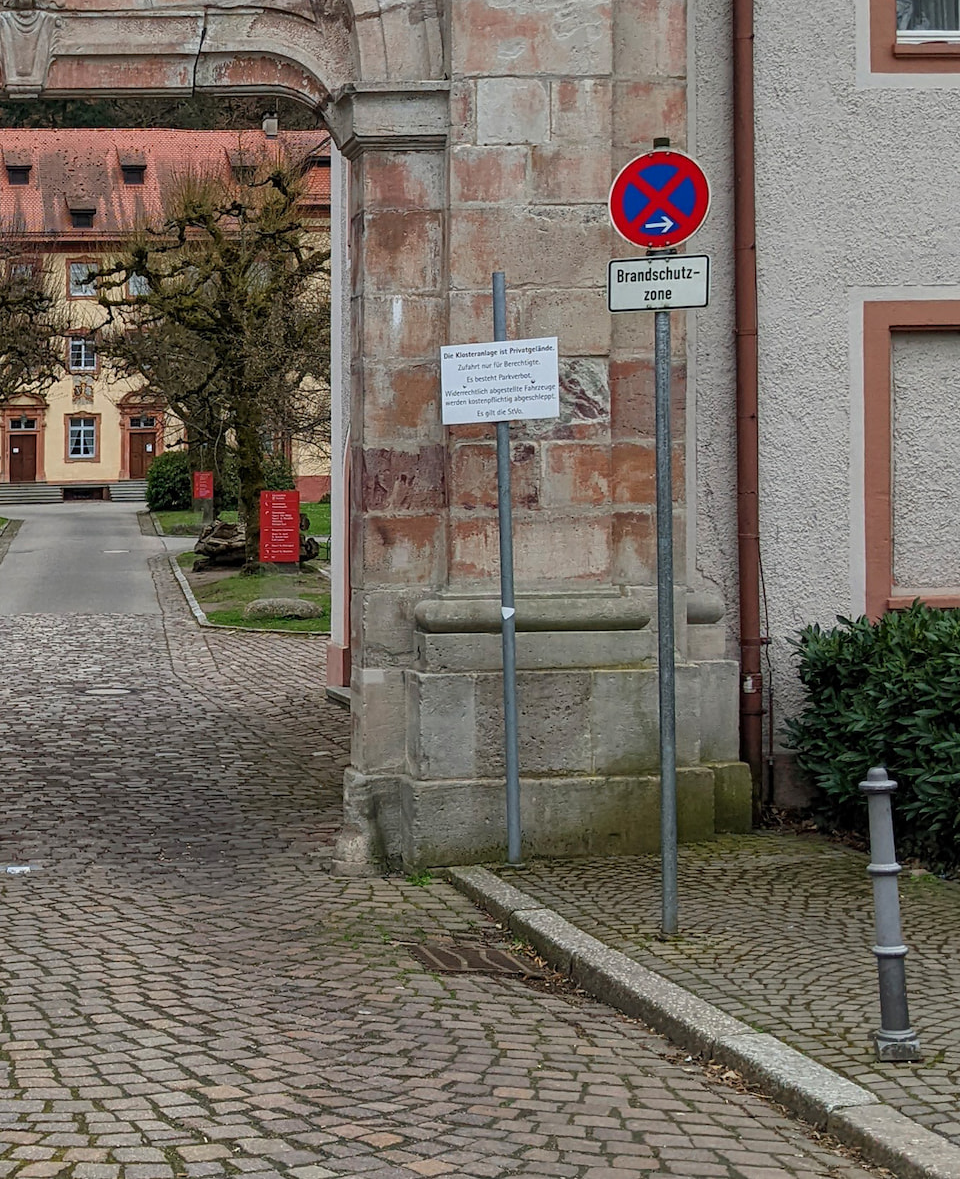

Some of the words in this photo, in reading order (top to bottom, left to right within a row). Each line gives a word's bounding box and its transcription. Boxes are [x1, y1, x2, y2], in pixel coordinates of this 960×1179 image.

[617, 265, 700, 283] Brandschutz-
[644, 289, 672, 301] zone
[455, 350, 498, 359] Klosteranlage
[509, 345, 555, 355] Privatgelände.
[504, 359, 541, 368] Berechtigte.
[474, 374, 497, 382] besteht
[498, 372, 532, 381] Parkverbot.
[445, 388, 488, 397] Widerrechtlich
[489, 385, 523, 395] abgestellte
[524, 383, 556, 392] Fahrzeuge
[468, 395, 512, 405] kostenpflichtig
[514, 393, 556, 402] abgeschleppt.
[485, 409, 496, 418] gilt
